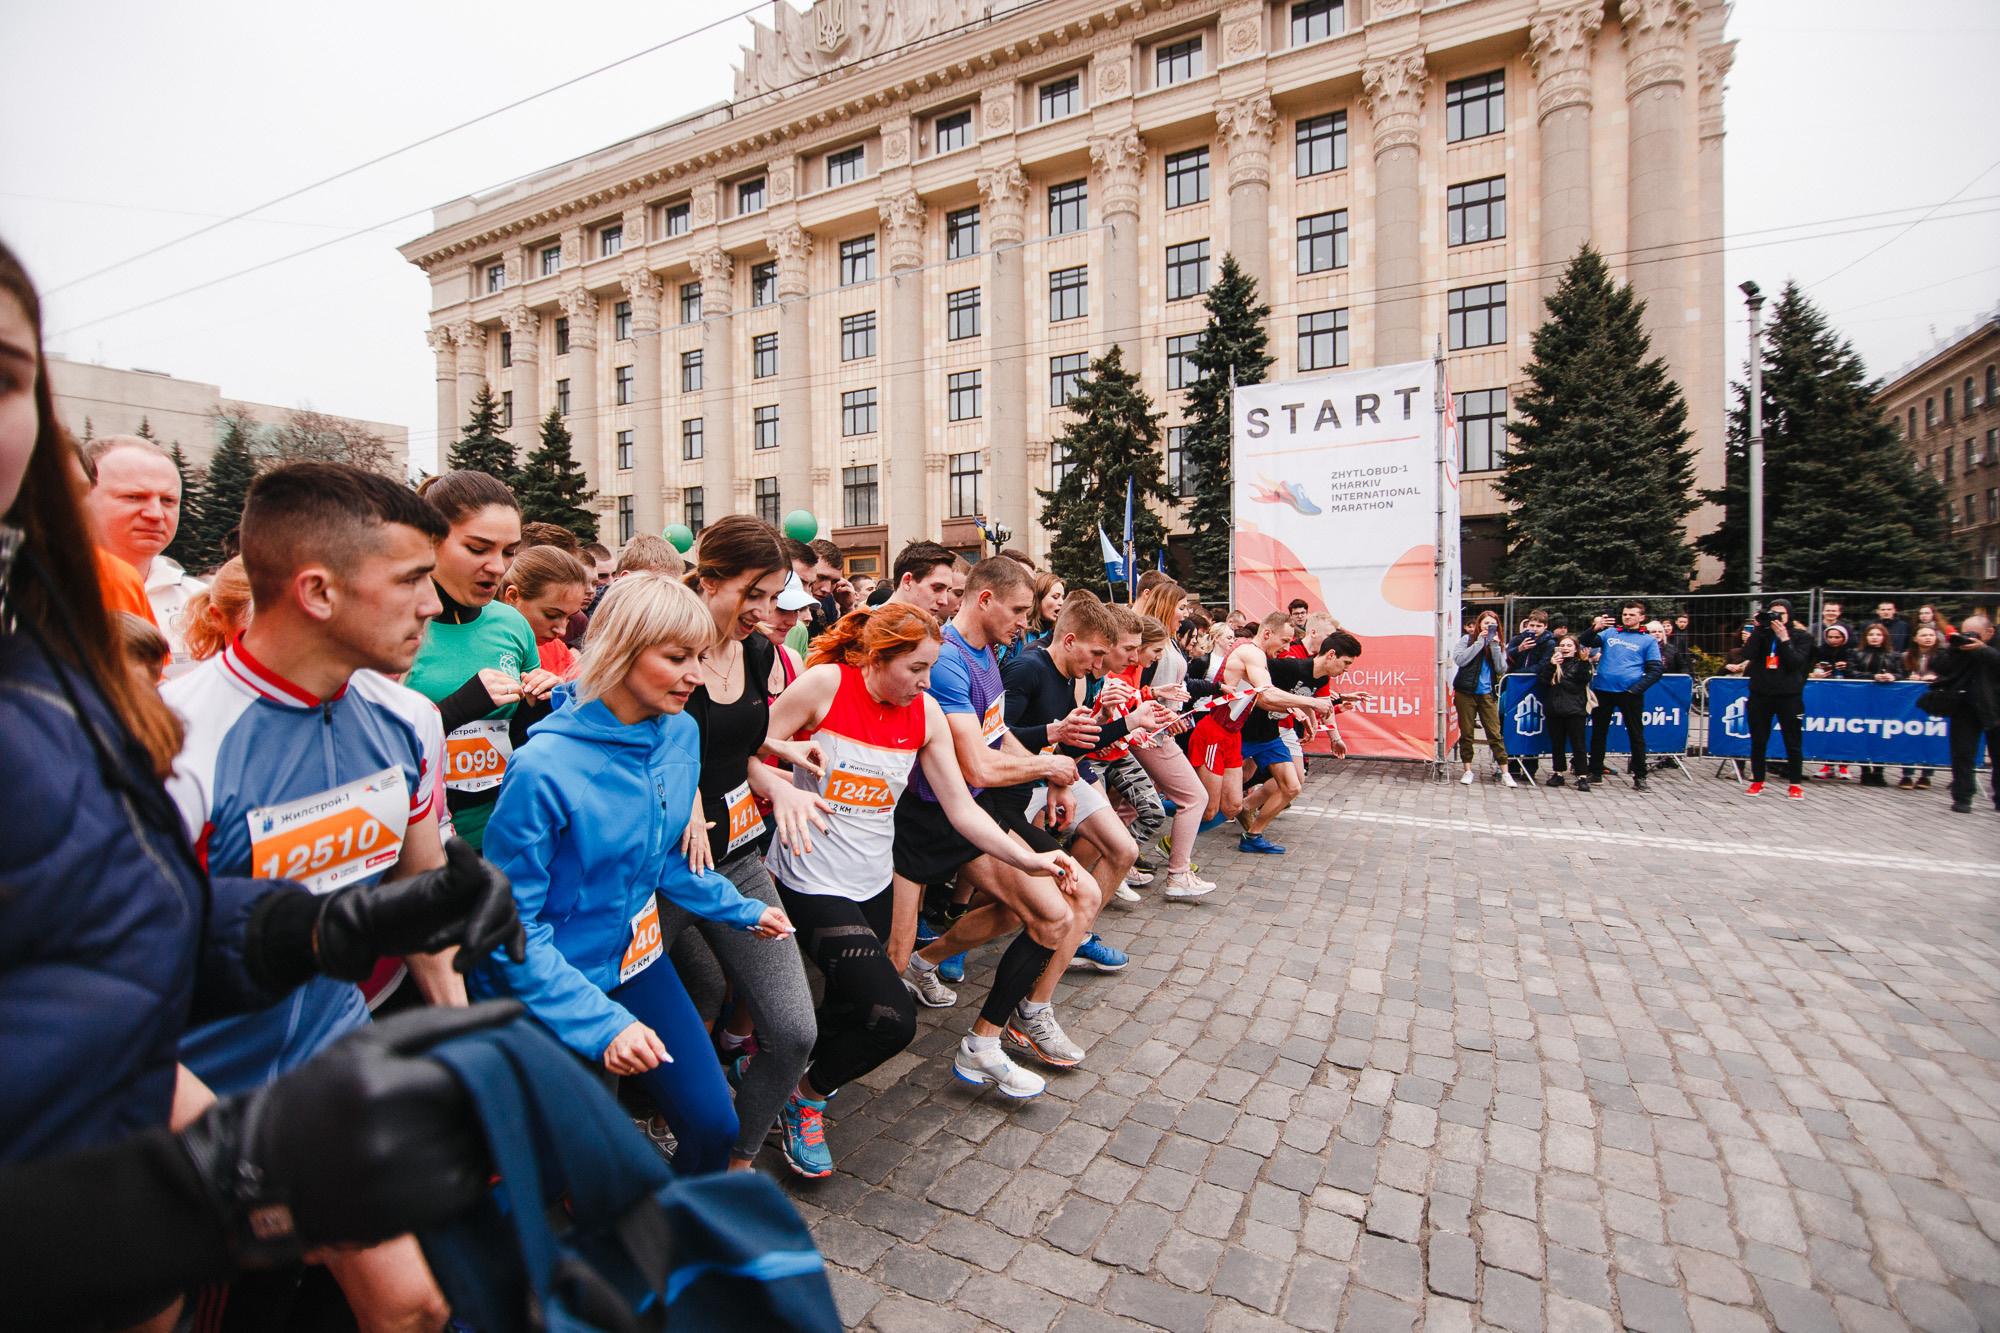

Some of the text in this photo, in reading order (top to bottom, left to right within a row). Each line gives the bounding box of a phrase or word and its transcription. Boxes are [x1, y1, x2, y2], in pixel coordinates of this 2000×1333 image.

[1246, 386, 1421, 439] START
[1331, 464, 1409, 480] ZHYTLOBUD-1
[1331, 478, 1382, 491] KHARKIV
[1331, 486, 1421, 502] INTERNATIONAL
[1331, 500, 1394, 513] MARATHON
[1774, 716, 1948, 740] илстрой
[848, 763, 885, 776] Жилстрой-1
[832, 780, 890, 803] 12474
[281, 793, 351, 825] Жилстрой-1
[262, 818, 381, 881] 12510
